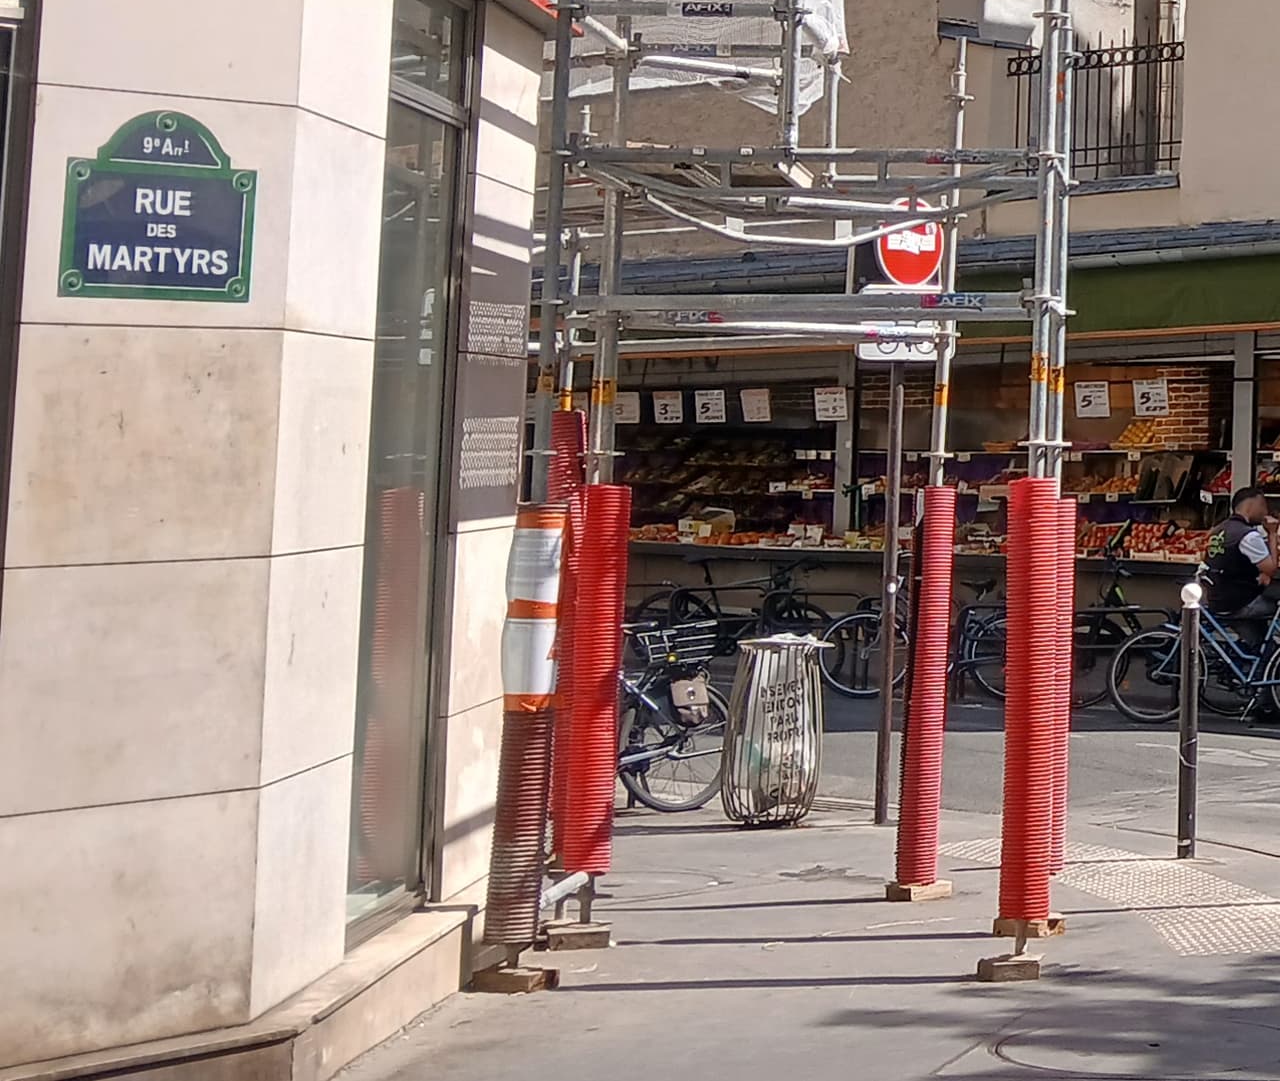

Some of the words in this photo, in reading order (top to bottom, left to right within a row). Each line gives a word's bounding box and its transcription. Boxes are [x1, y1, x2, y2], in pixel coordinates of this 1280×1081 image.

[136, 188, 191, 216] RUE
[147, 223, 177, 238] DES
[87, 244, 229, 275] MARTYRS
[940, 295, 984, 307] AFIX
[1081, 394, 1093, 408] 5
[1140, 391, 1151, 405] 5
